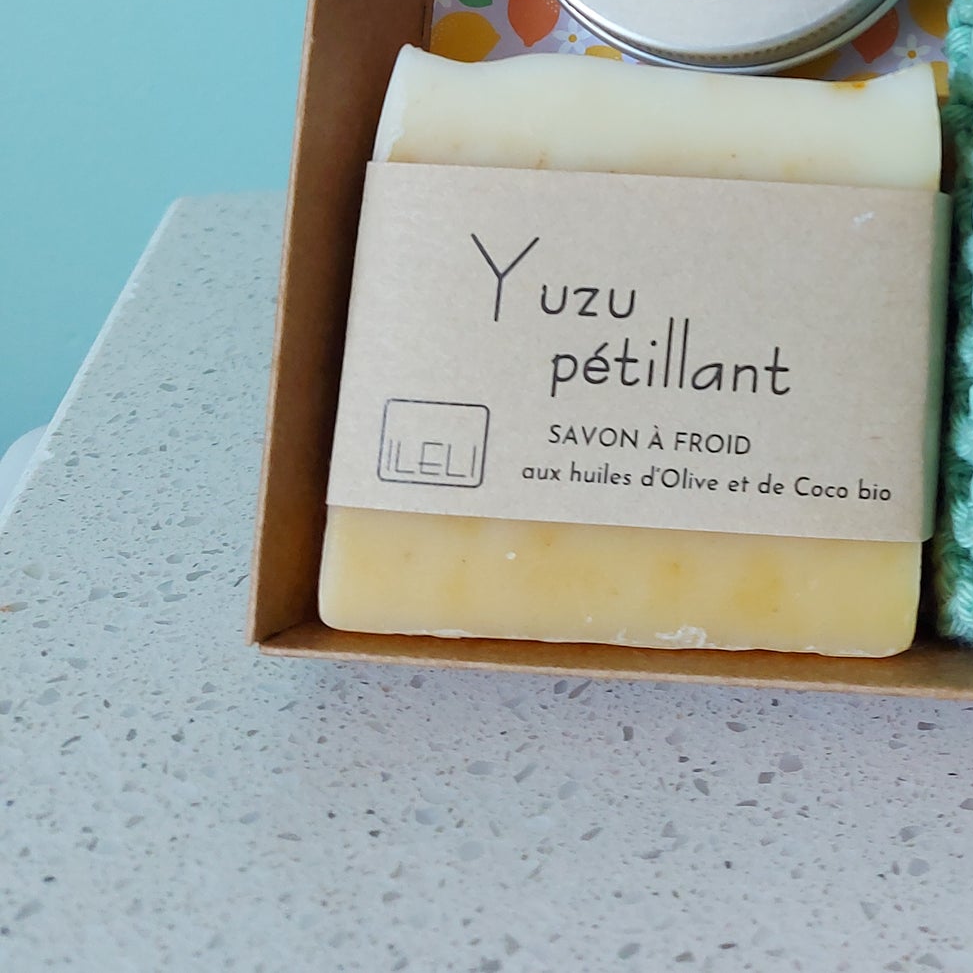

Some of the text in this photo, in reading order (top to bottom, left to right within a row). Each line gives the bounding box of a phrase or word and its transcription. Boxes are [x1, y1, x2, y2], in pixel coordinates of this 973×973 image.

[549, 316, 792, 398] pétillant
[547, 424, 751, 456] SAVON À FROID
[521, 461, 892, 502] aux huiles d'Olive et de Coco bio
